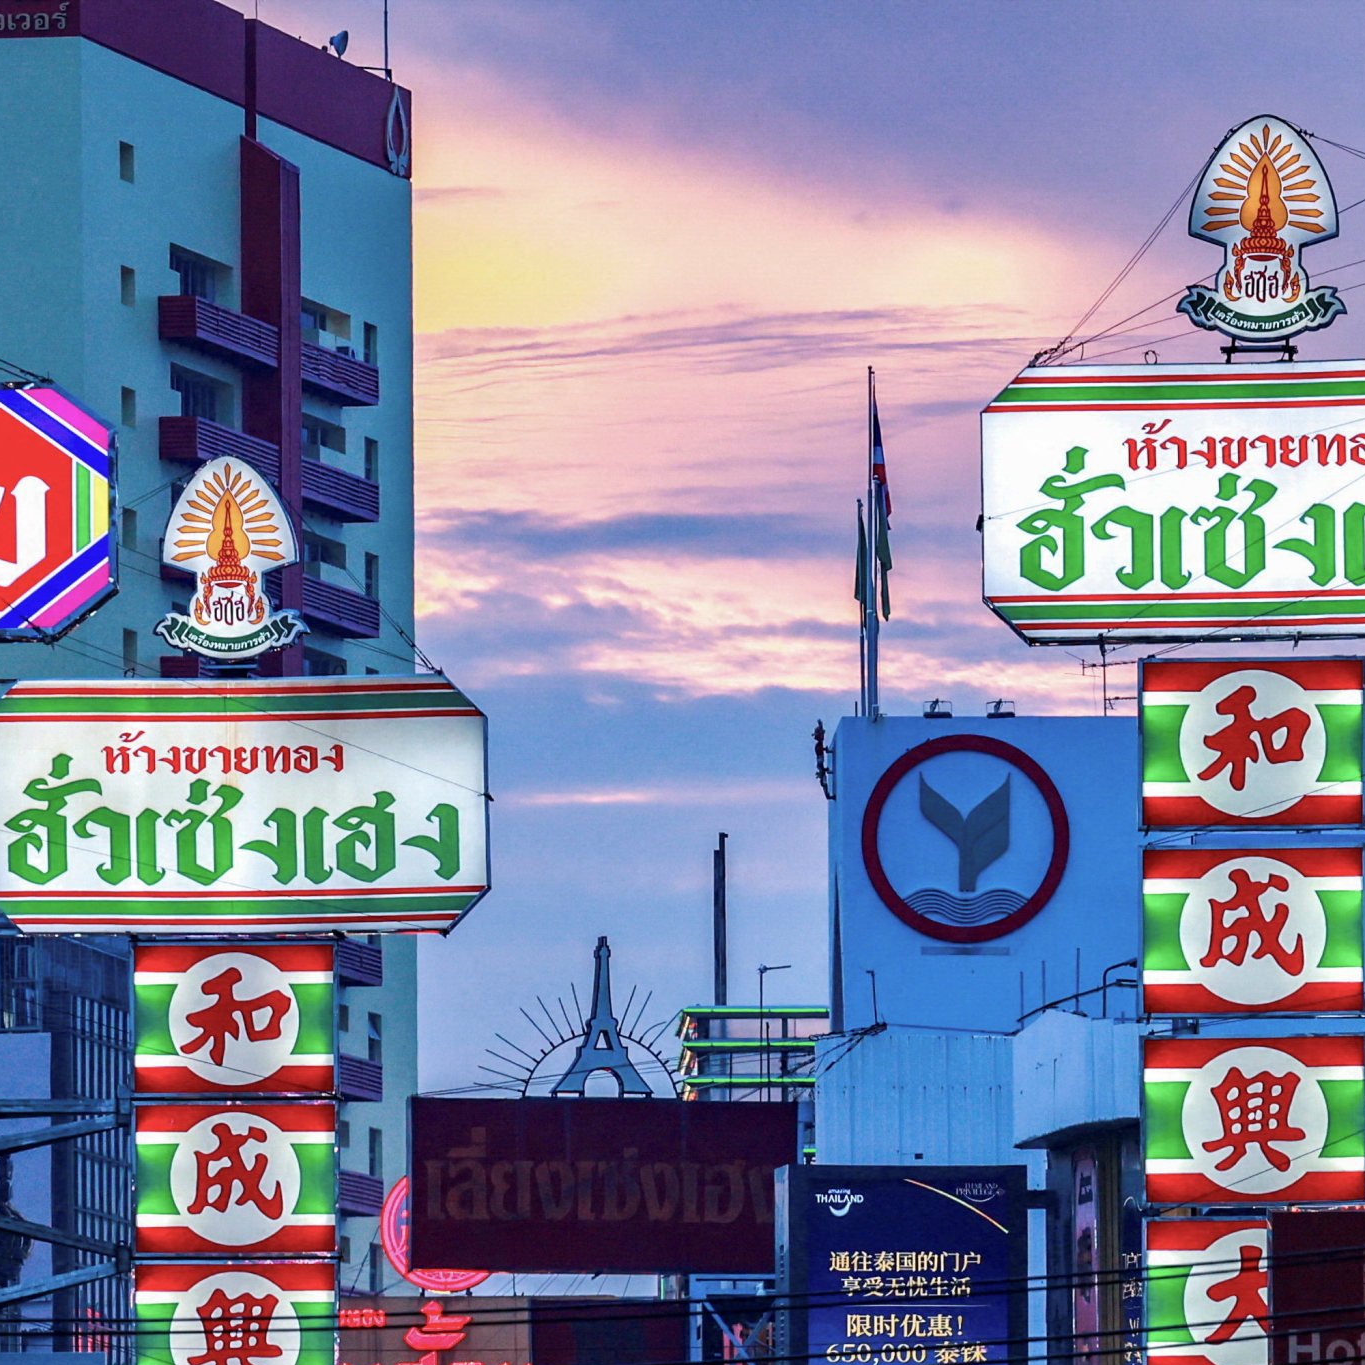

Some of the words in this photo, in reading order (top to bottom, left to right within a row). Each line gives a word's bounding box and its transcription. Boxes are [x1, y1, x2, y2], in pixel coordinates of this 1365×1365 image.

[1214, 309, 1306, 331] เครื่องหมายการค้า
[187, 630, 271, 653] เครื่องหมายการค้า
[102, 732, 341, 774] ห้างขายทอง
[4, 753, 460, 886] ฮั่วเซ่งเฮง
[815, 1194, 864, 1203] THAILAND
[829, 1251, 982, 1272] 通往泰国的门户
[840, 1276, 972, 1297] 享受无忧生活
[825, 1343, 927, 1365] 650,000
